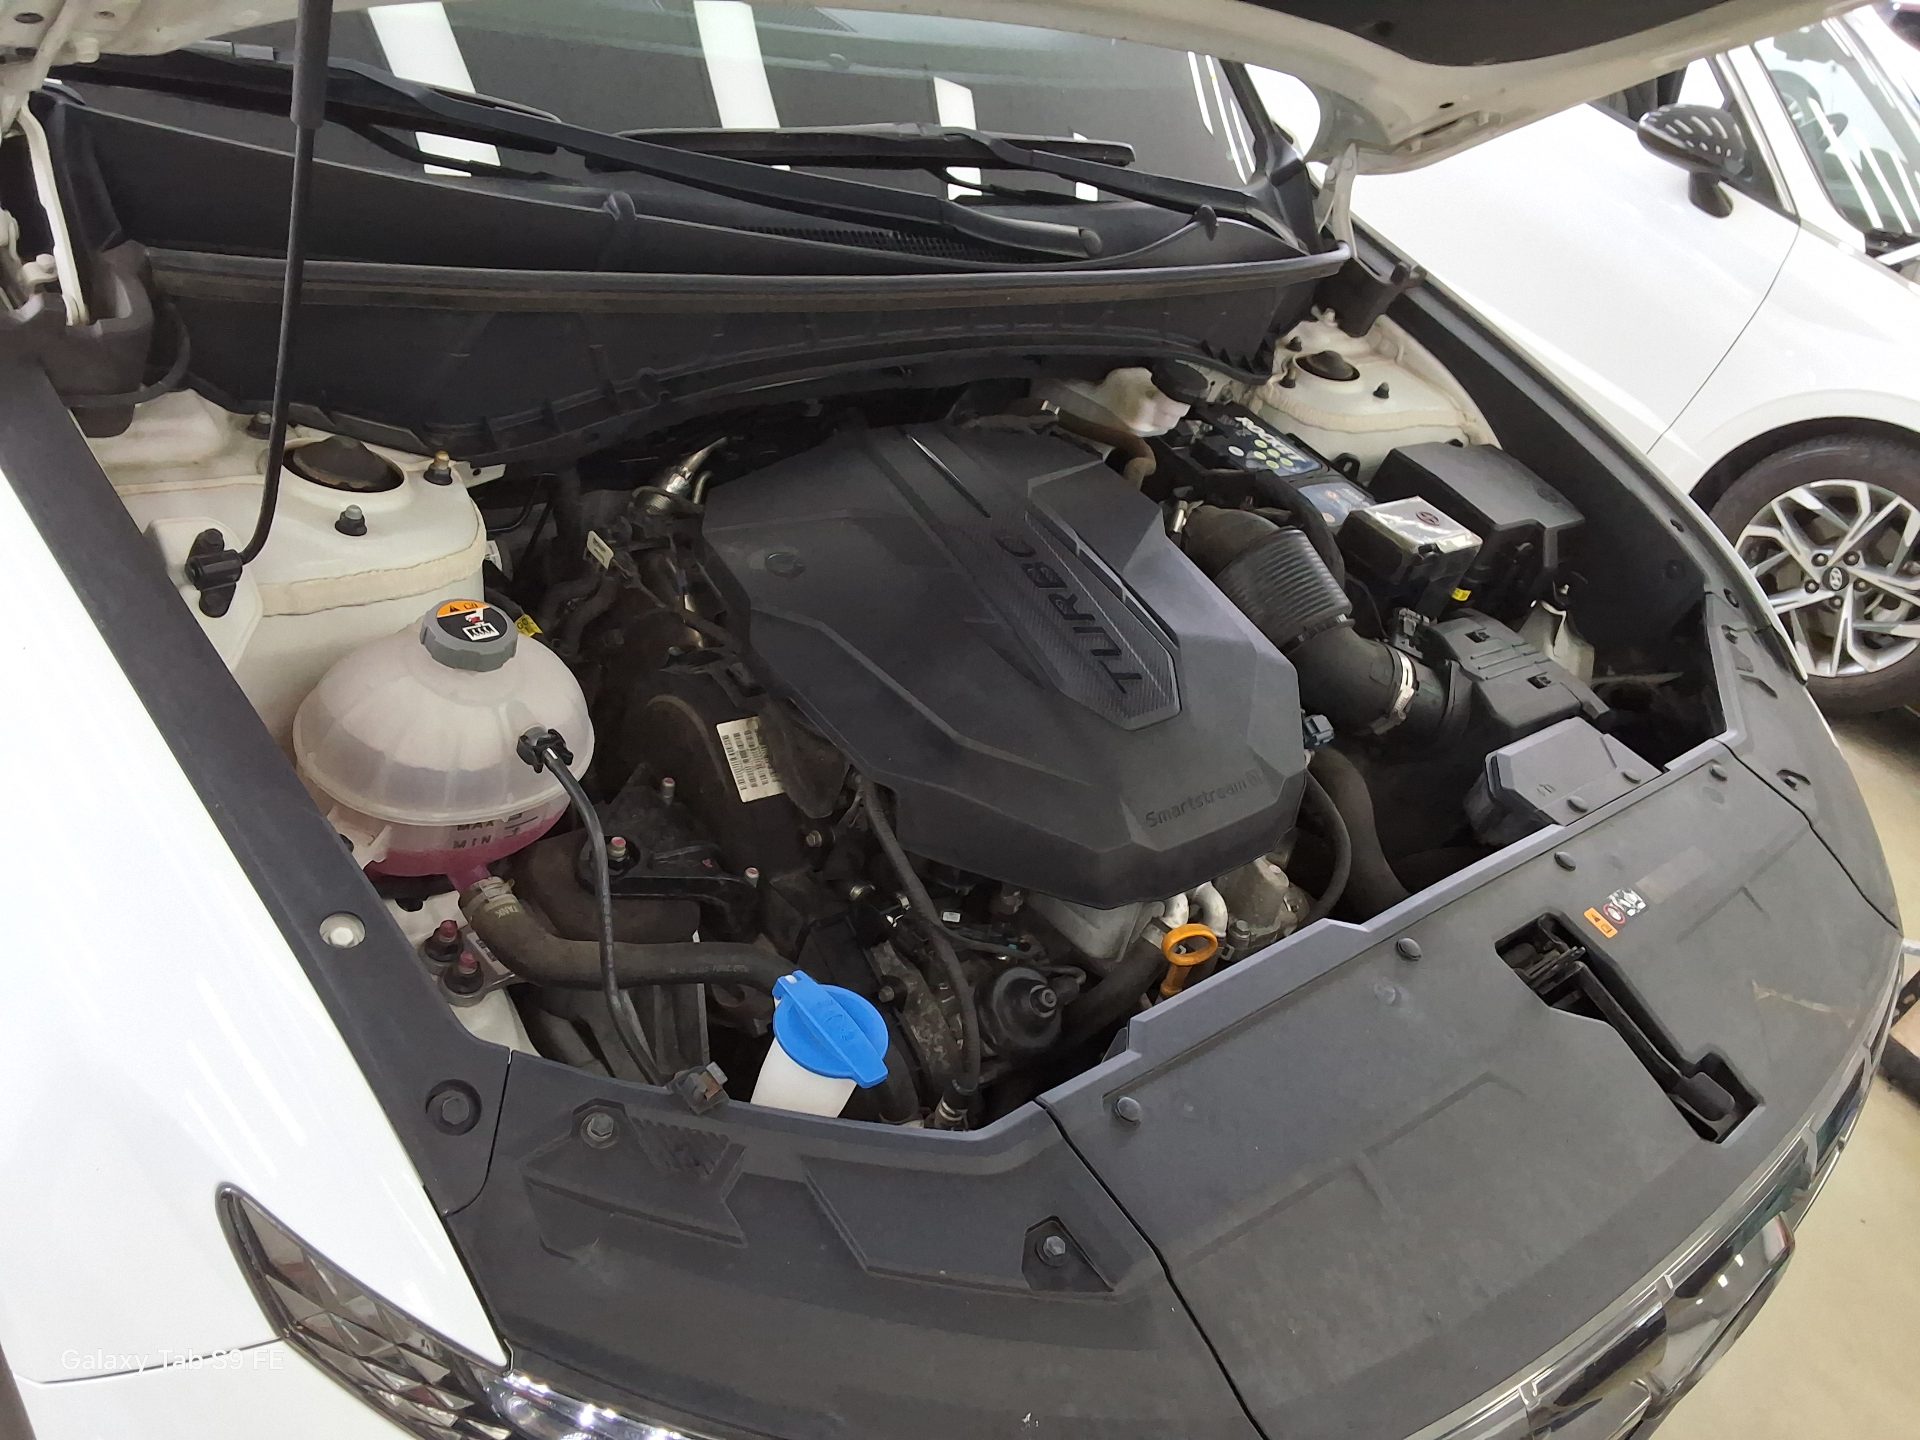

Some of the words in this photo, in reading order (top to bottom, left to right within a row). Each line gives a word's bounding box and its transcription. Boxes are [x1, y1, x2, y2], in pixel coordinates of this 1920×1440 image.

[994, 531, 1143, 694] TURBO
[1144, 779, 1247, 828] Smartstream
[453, 835, 492, 849] MIN
